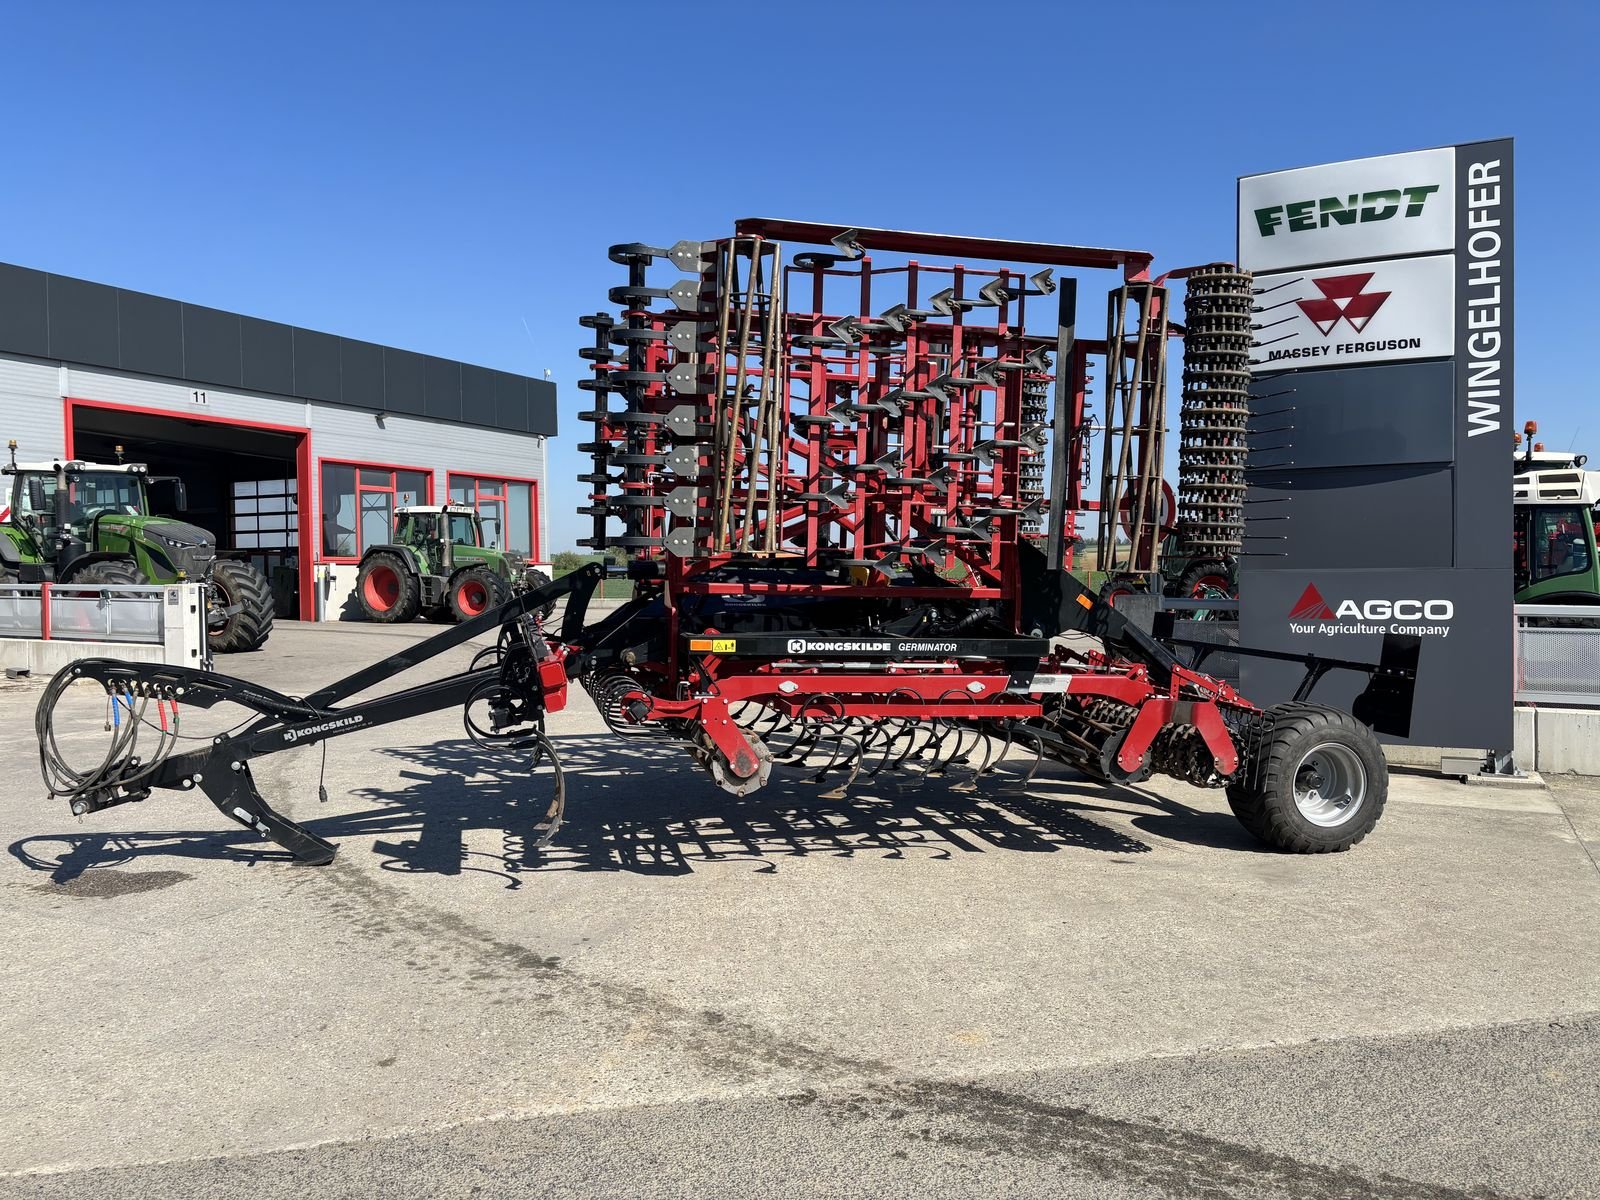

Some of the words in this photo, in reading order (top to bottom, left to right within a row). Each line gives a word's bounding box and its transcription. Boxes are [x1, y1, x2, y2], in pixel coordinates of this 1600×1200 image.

[1253, 184, 1440, 238] FENDT
[1467, 158, 1501, 438] WINGELHOFER
[1268, 345, 1331, 361] MASSEY
[1336, 337, 1421, 355] FERGUSON
[193, 391, 206, 404] 11
[1335, 599, 1454, 621] AGCO
[1289, 623, 1316, 634] Your
[1318, 623, 1386, 637] Agriculture
[1389, 623, 1450, 638] Company
[806, 641, 891, 652] KONGSKILDE
[898, 642, 958, 653] GERMINATOR
[297, 715, 363, 737] KONGSKILD
